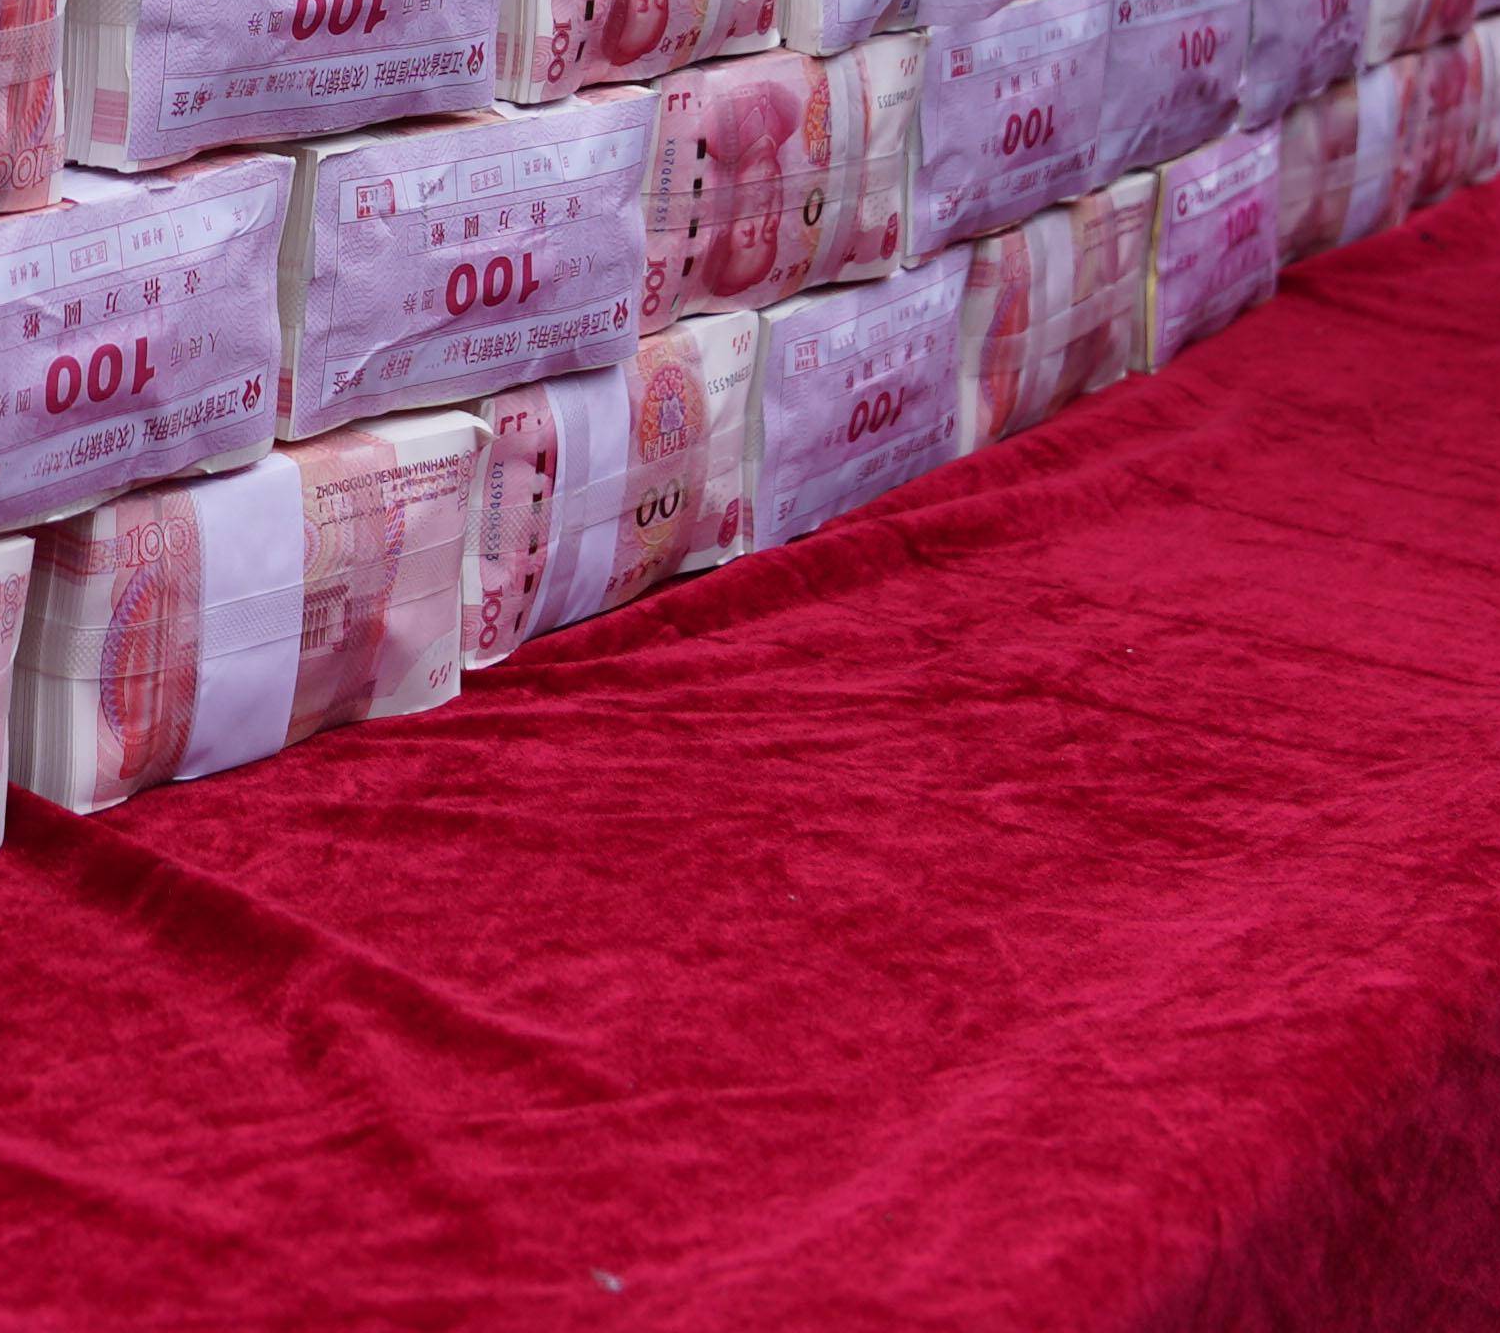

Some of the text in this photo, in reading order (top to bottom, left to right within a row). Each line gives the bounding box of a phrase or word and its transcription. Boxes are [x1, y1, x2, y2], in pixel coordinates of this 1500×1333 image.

[547, 18, 571, 83] 100
[1178, 27, 1218, 71] 100
[1002, 105, 1054, 155] 100
[430, 197, 581, 246] 壹拾万圆整
[445, 252, 540, 317] 100
[553, 253, 597, 283] 人民币
[641, 256, 667, 317] 100
[23, 268, 199, 338] 壹拾万圆整
[170, 328, 221, 366] 人民币
[44, 337, 155, 415] 100
[847, 387, 904, 443] 100
[315, 453, 460, 499] ZHONGGUO RENMIN YINHANG
[126, 517, 194, 568] 100
[479, 588, 502, 649] 100
